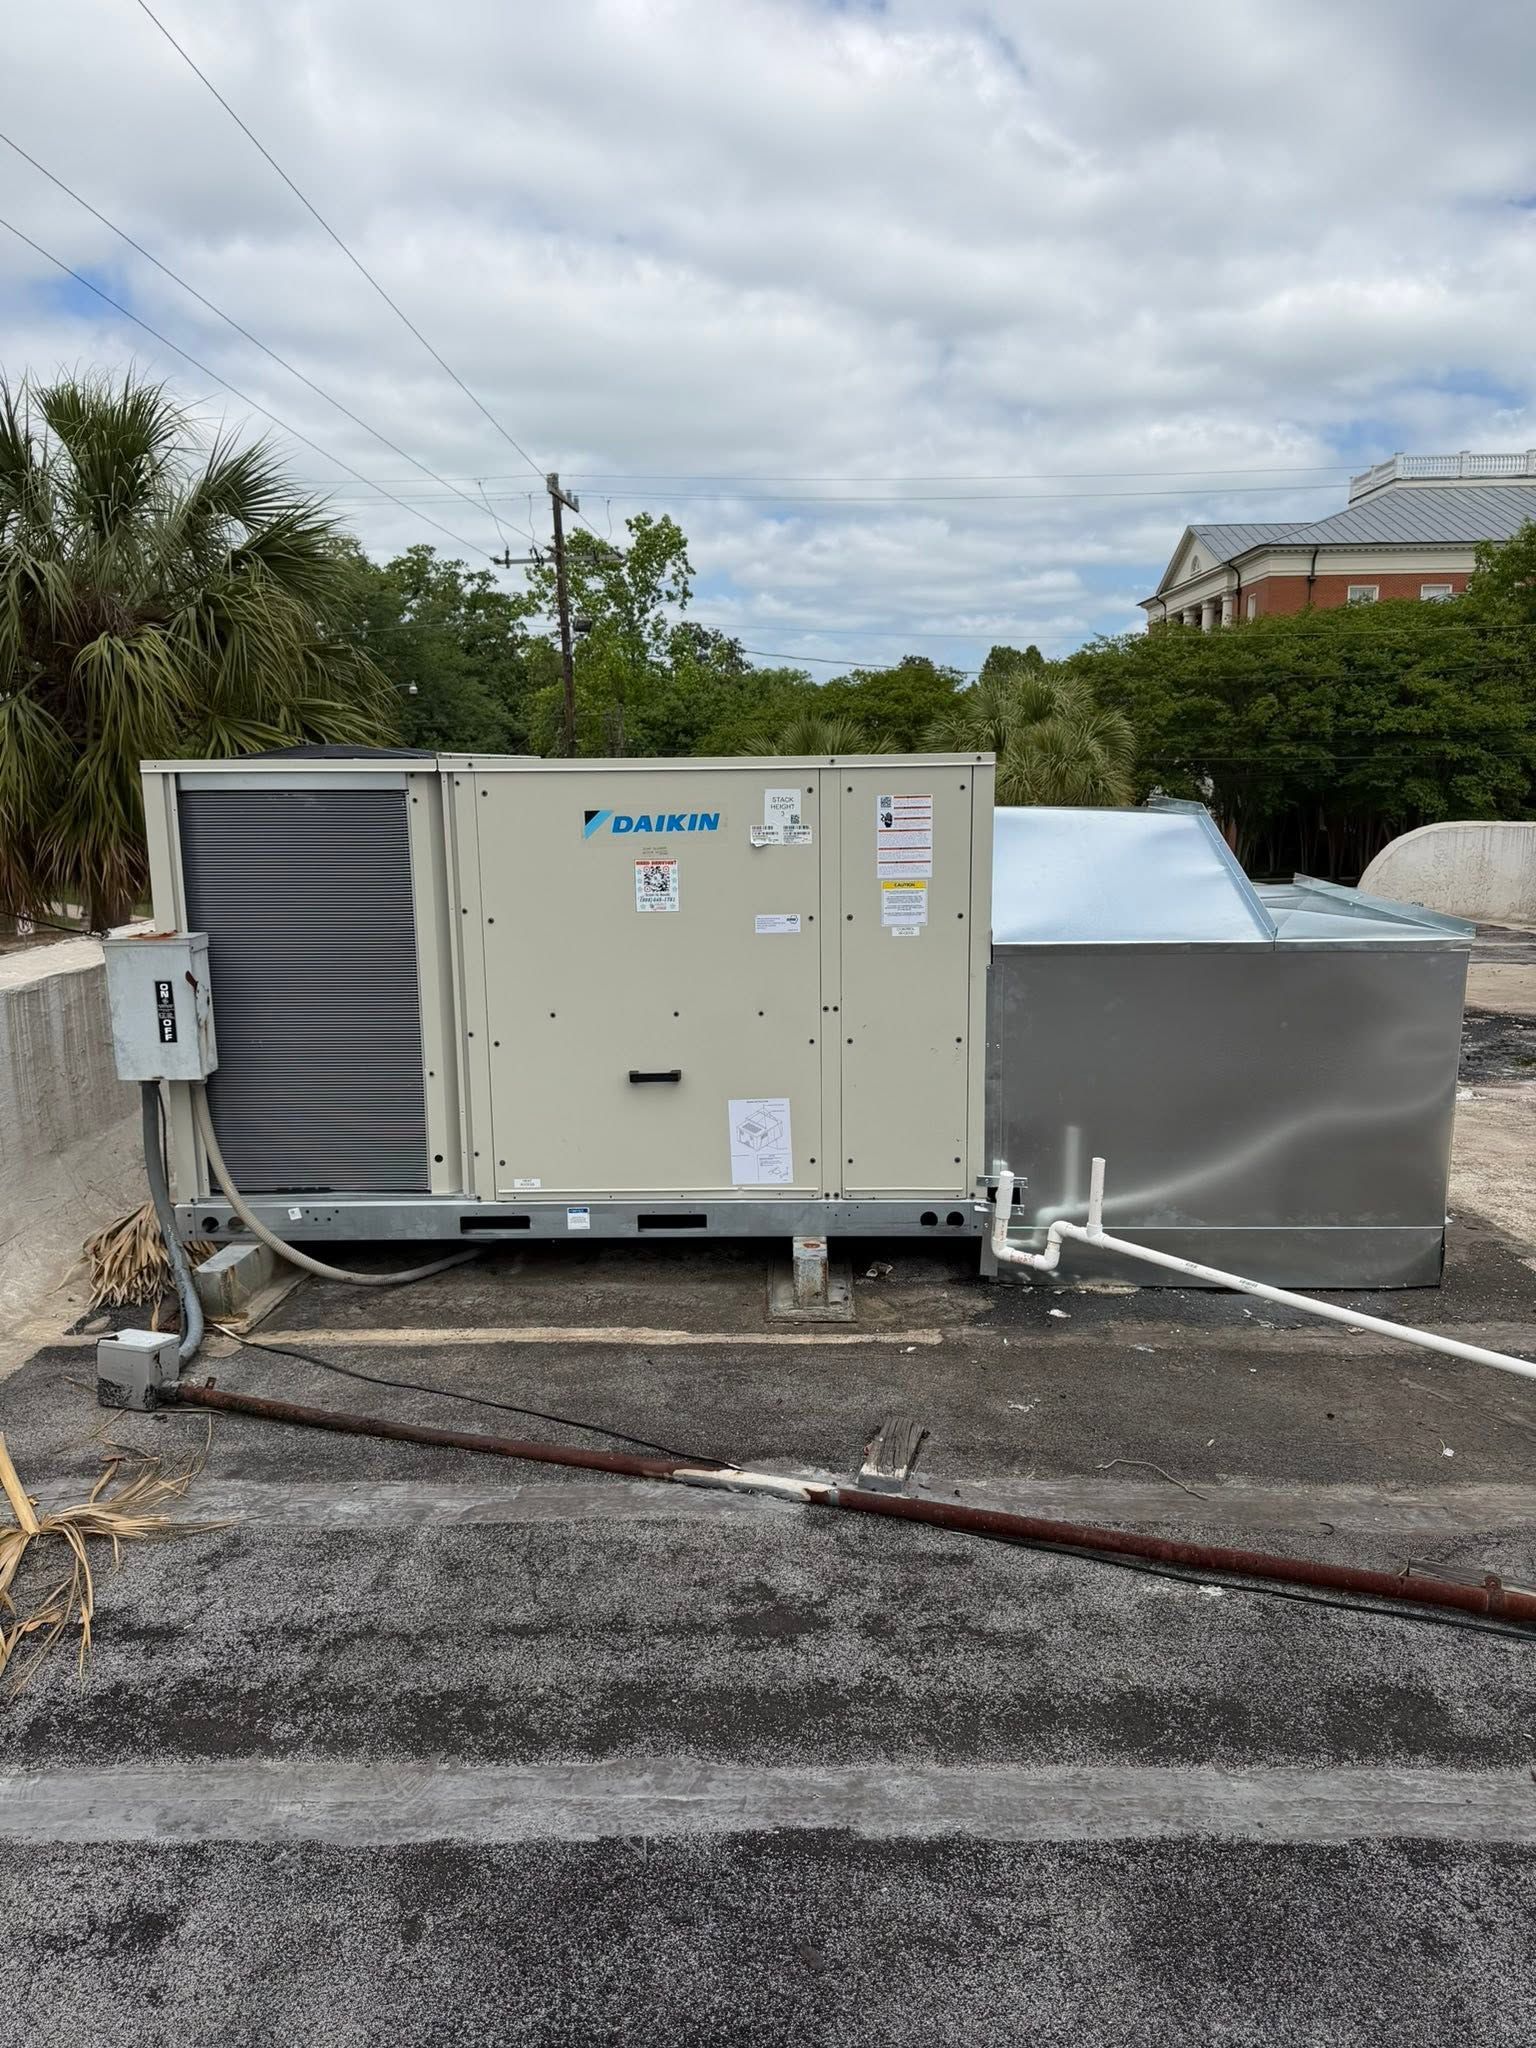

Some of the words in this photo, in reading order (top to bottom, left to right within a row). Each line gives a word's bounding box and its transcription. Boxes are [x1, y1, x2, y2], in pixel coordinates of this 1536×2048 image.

[612, 812, 721, 834] DAIKIN
[159, 983, 169, 998] ON
[162, 1019, 173, 1042] OFF
